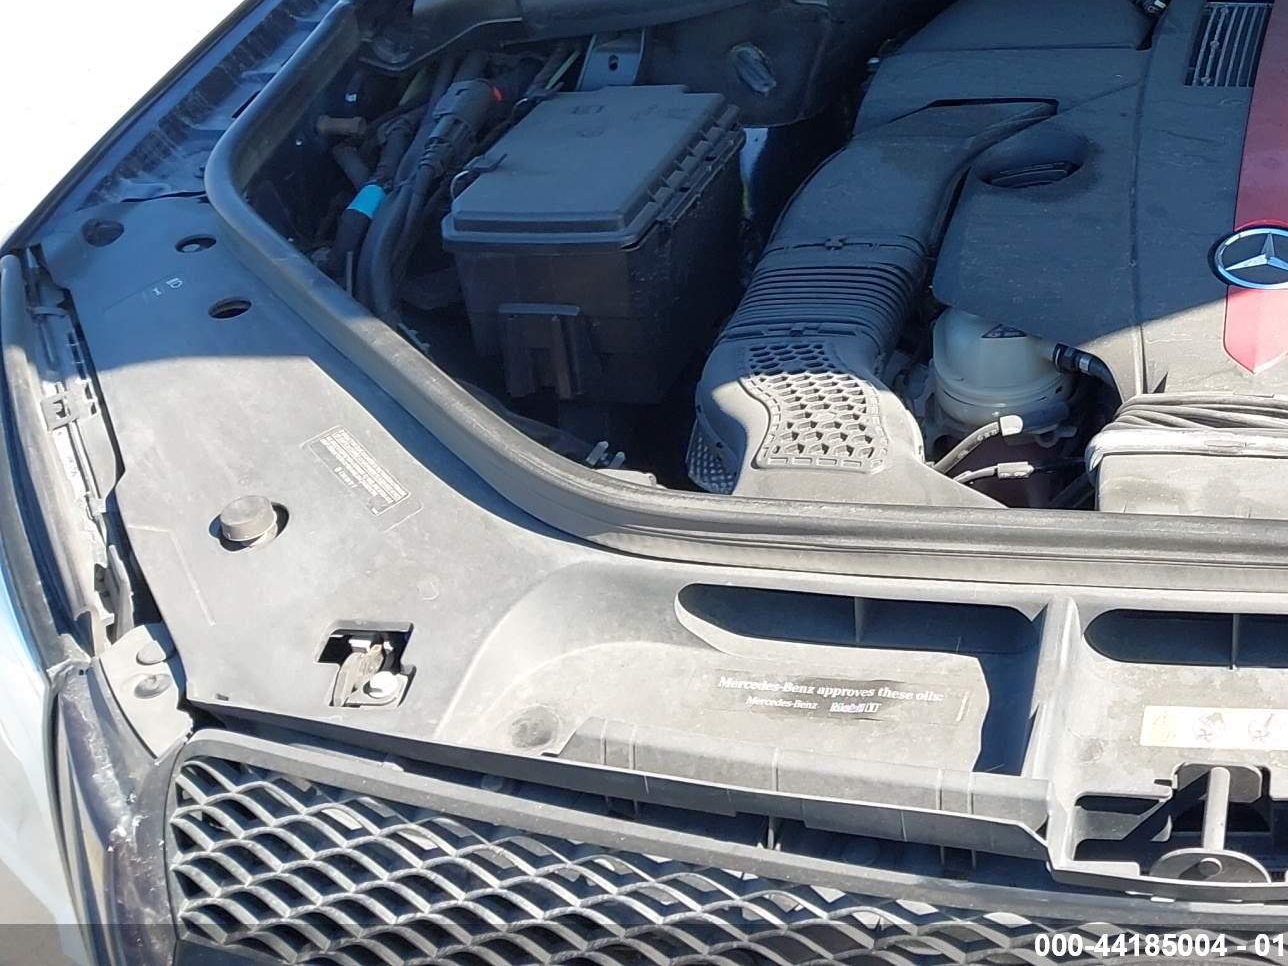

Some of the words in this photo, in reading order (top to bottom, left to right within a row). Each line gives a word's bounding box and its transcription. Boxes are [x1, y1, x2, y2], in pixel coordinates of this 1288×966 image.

[718, 676, 816, 695] Mercedes-Benz
[817, 685, 875, 698] approves
[878, 687, 916, 700] these
[916, 690, 945, 702] oils:
[745, 696, 818, 709] Mercedes-Benz
